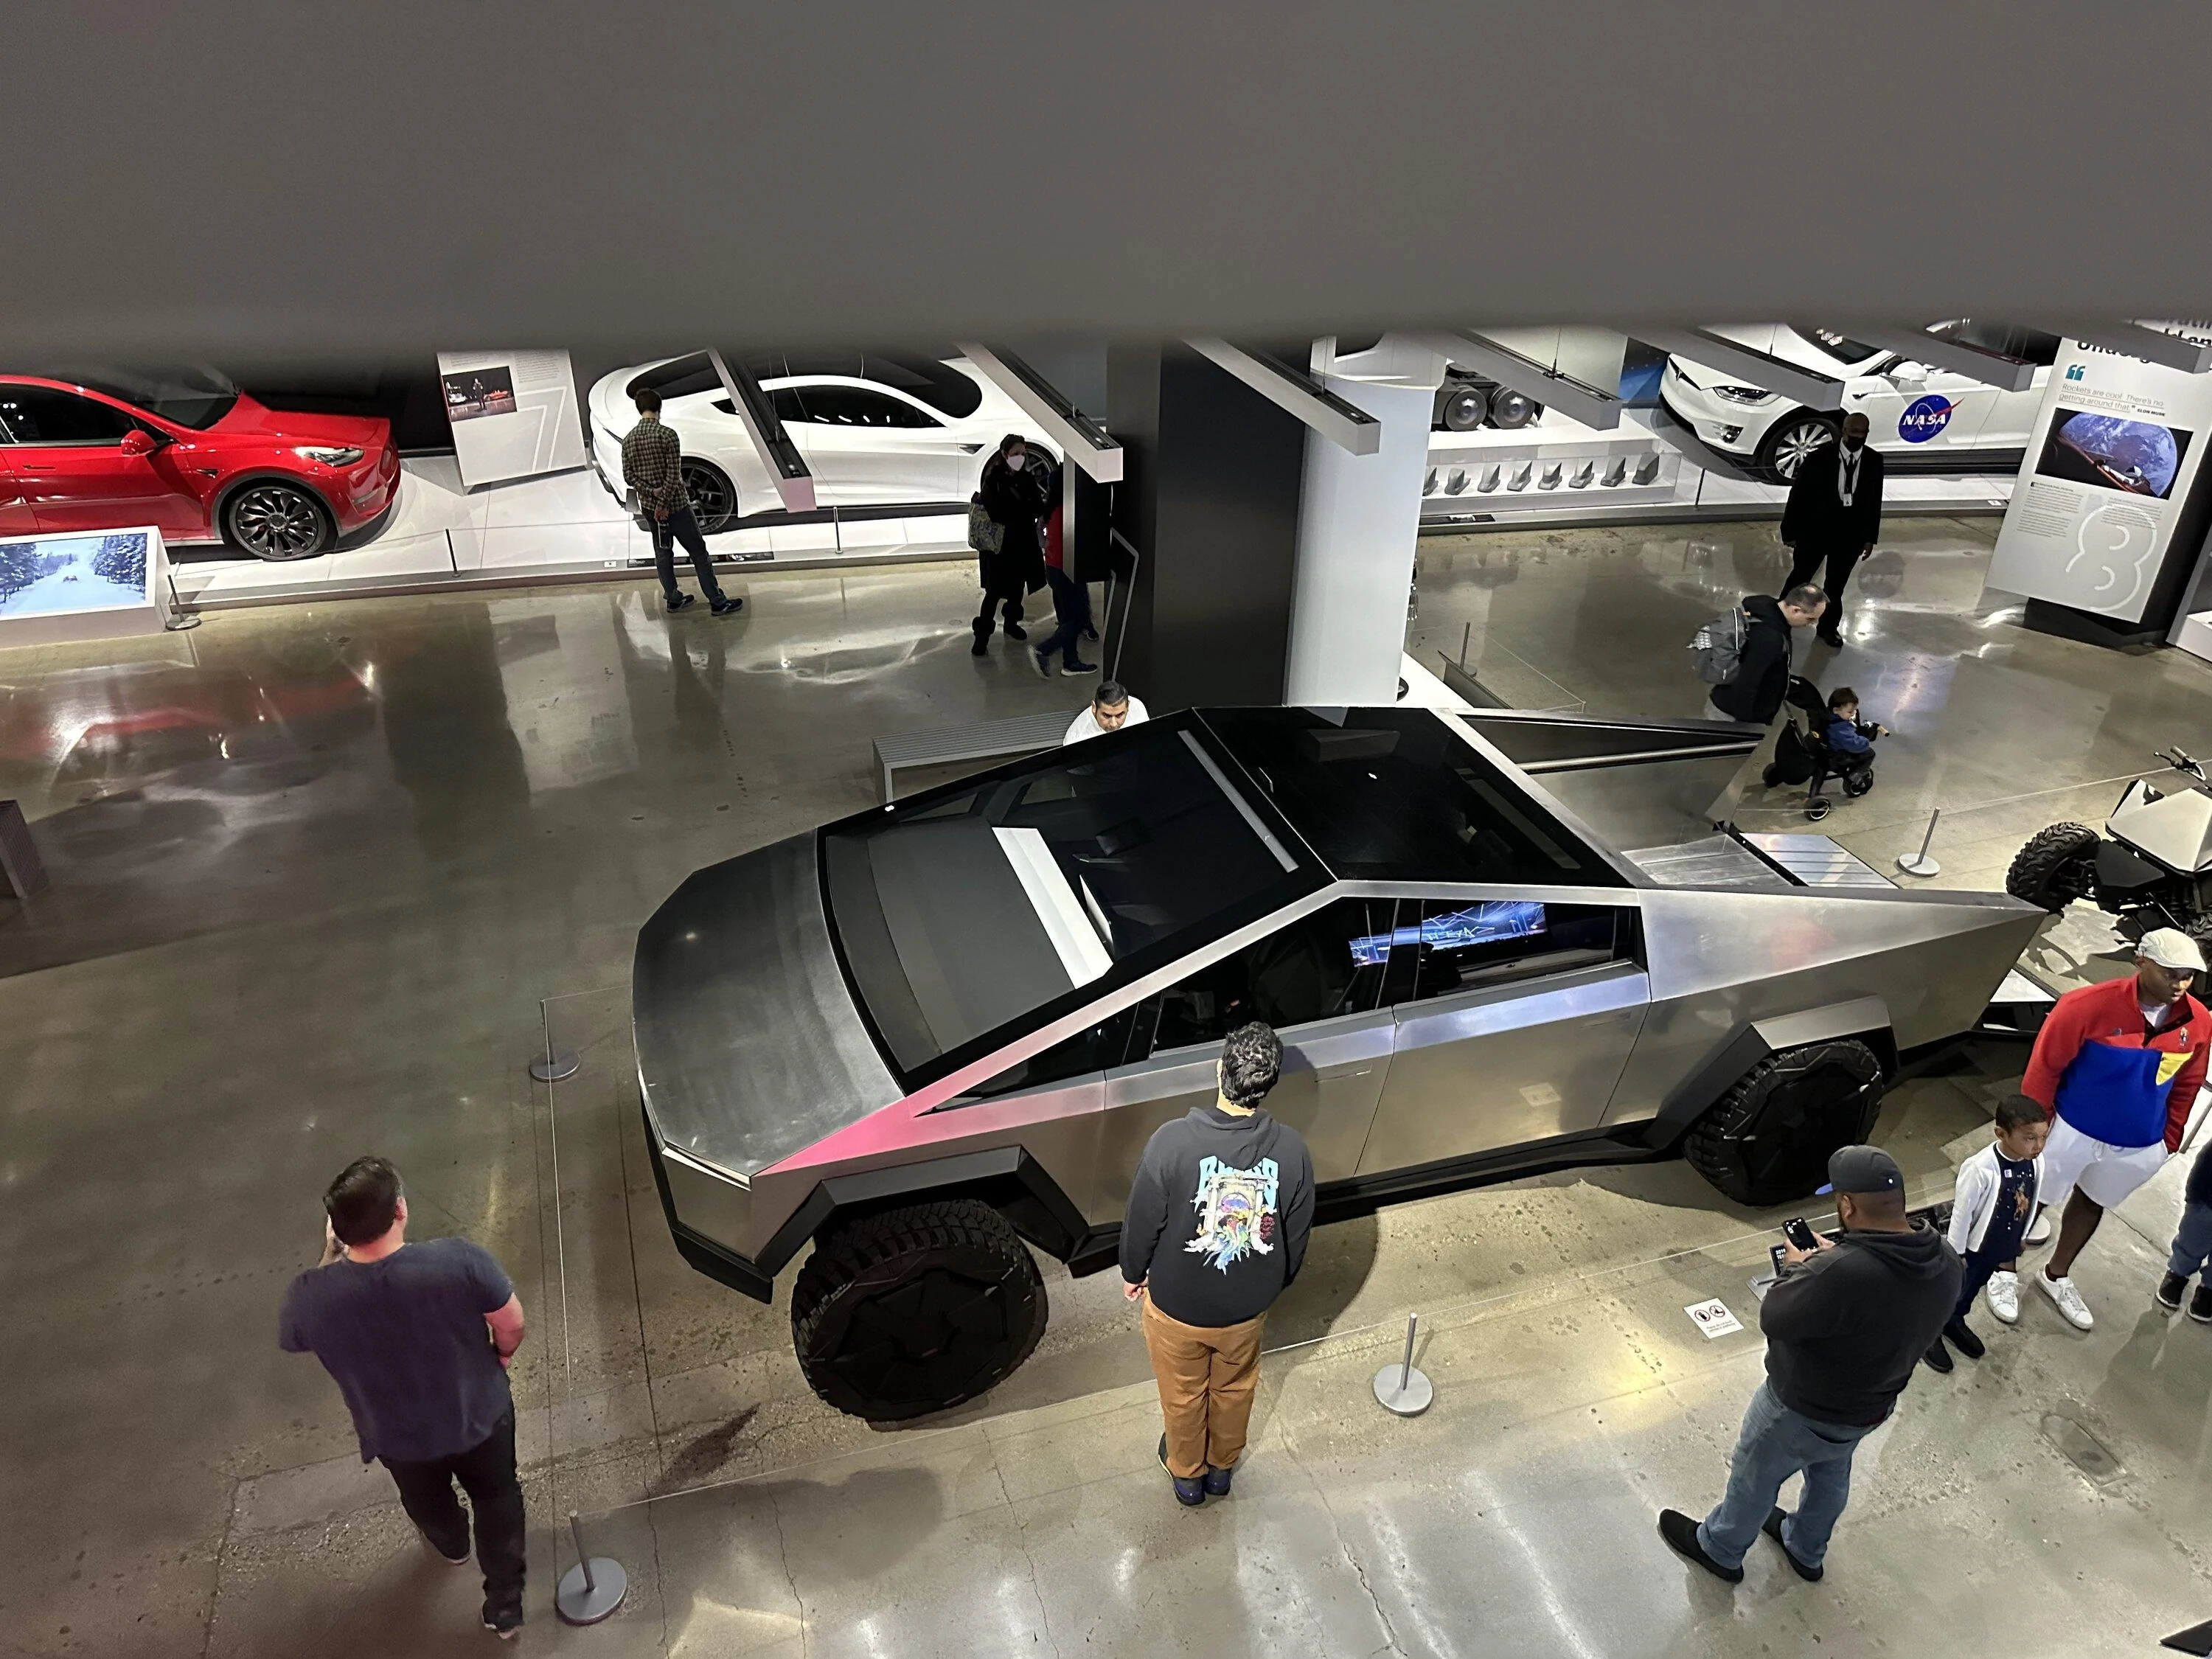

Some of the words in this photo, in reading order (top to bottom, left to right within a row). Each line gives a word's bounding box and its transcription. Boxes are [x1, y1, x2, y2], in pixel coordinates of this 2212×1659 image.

[2059, 394, 2085, 404] getting
[2086, 397, 2114, 408] around
[2062, 383, 2091, 394] Rockets
[2126, 394, 2152, 405] There's
[1902, 414, 1946, 425] NASA
